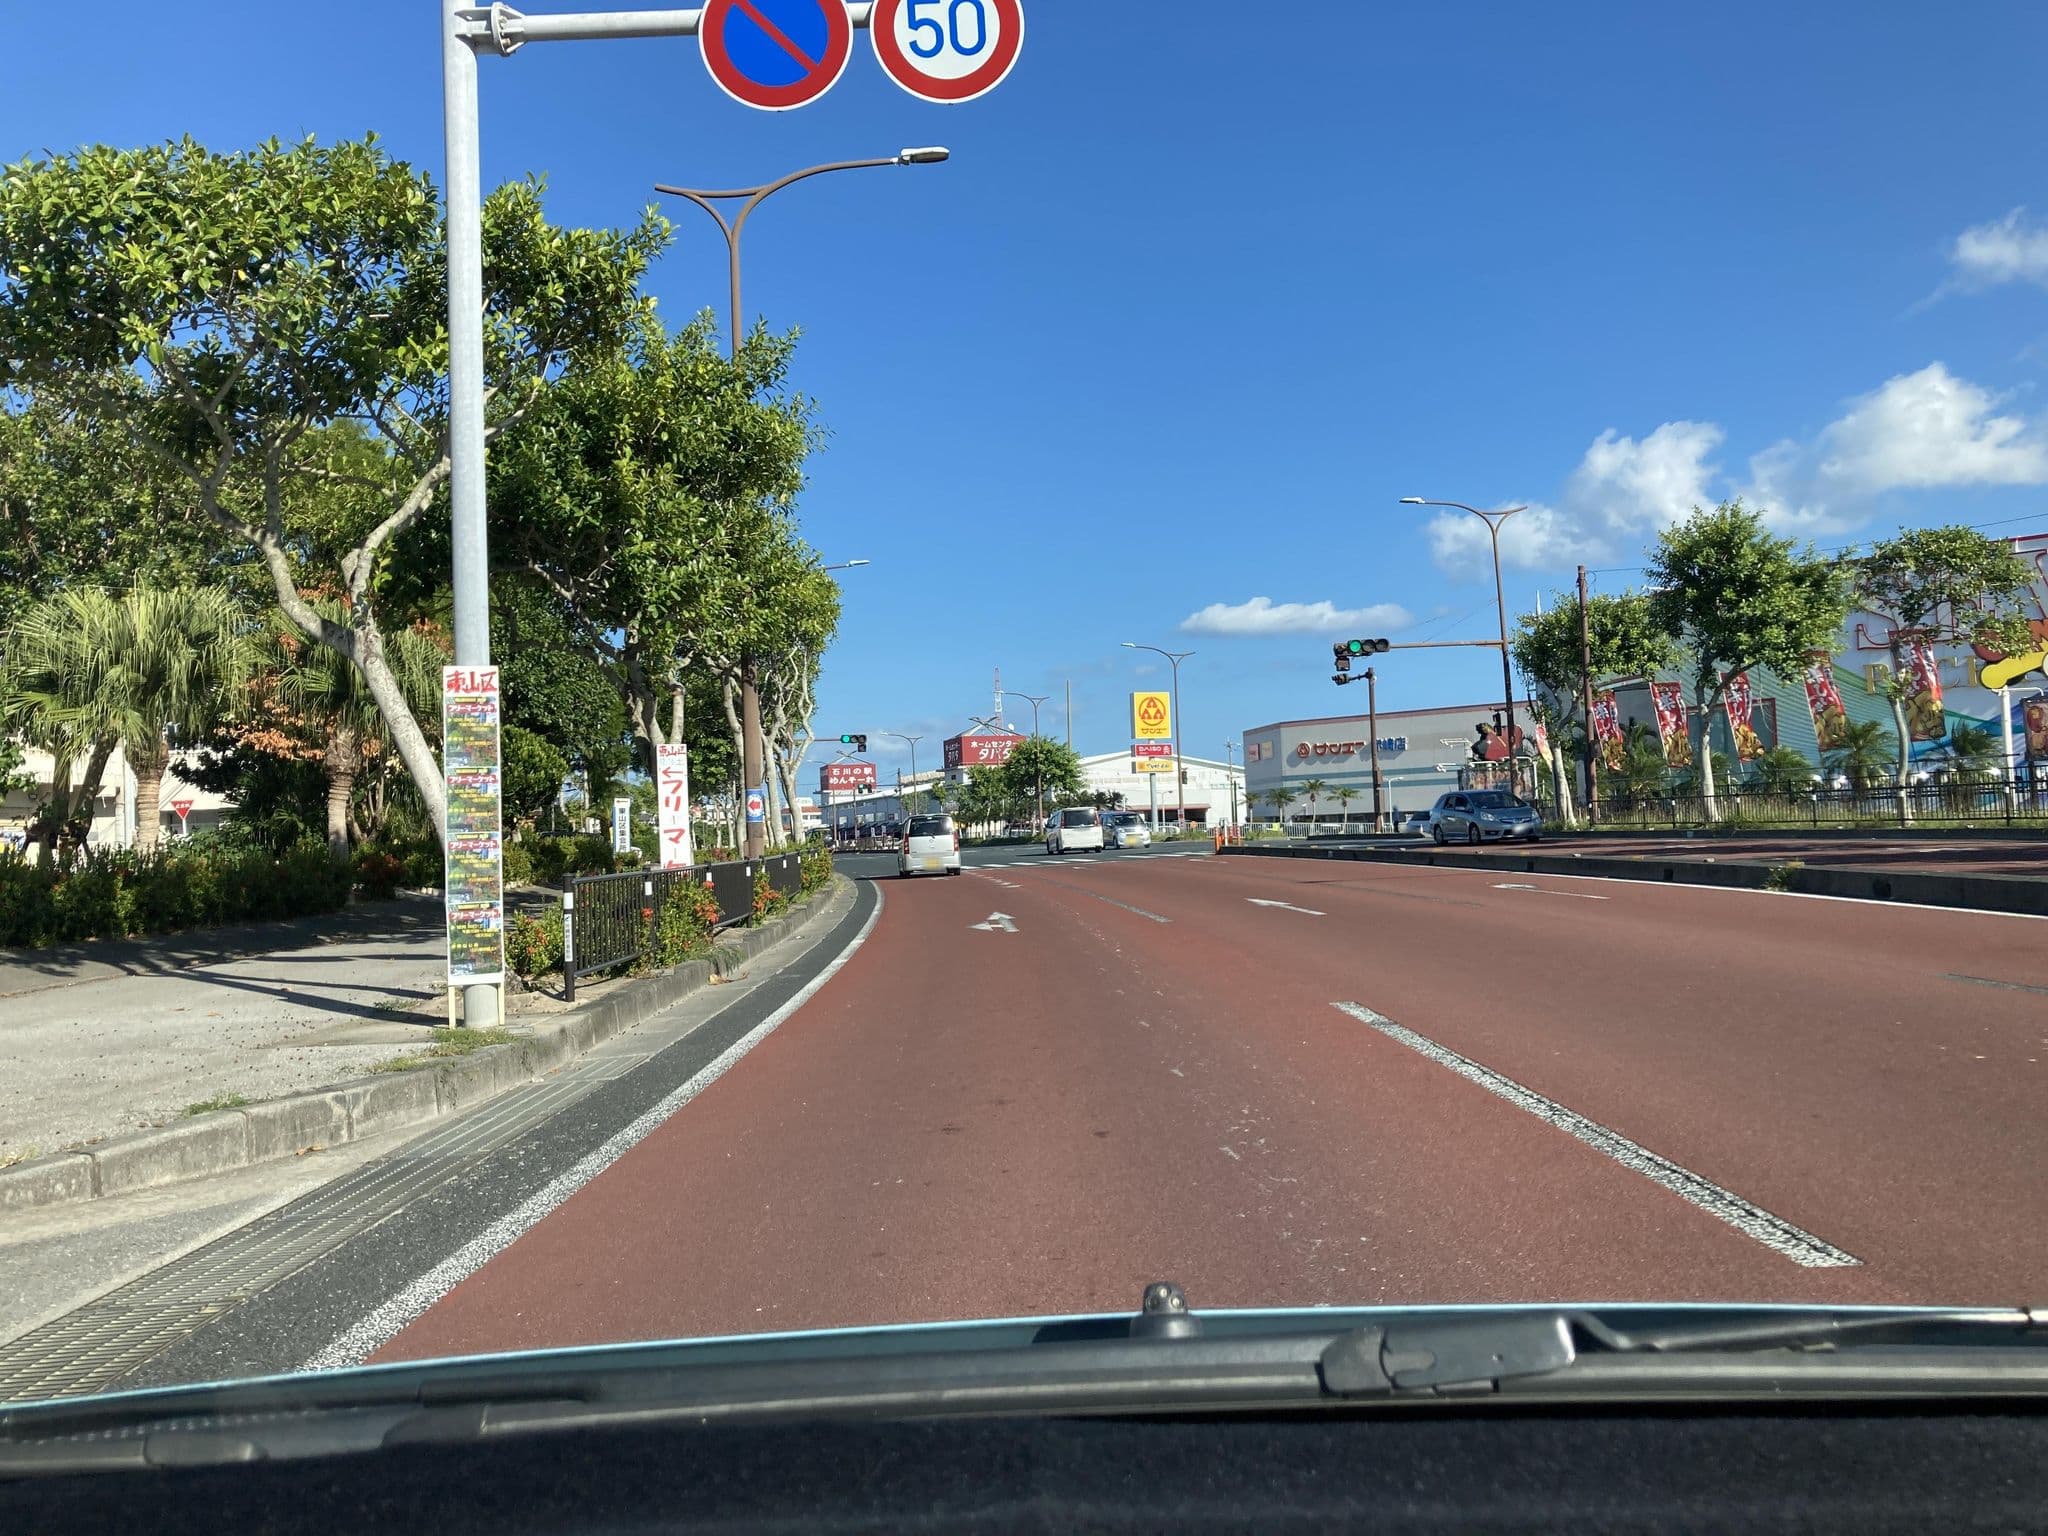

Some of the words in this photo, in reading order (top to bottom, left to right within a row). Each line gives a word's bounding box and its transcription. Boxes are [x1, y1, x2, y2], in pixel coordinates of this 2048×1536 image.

[907, 0, 986, 58] 50
[1313, 741, 1364, 756] サンエー
[832, 767, 872, 775] 石川の駅
[829, 776, 875, 784] めんそーれ
